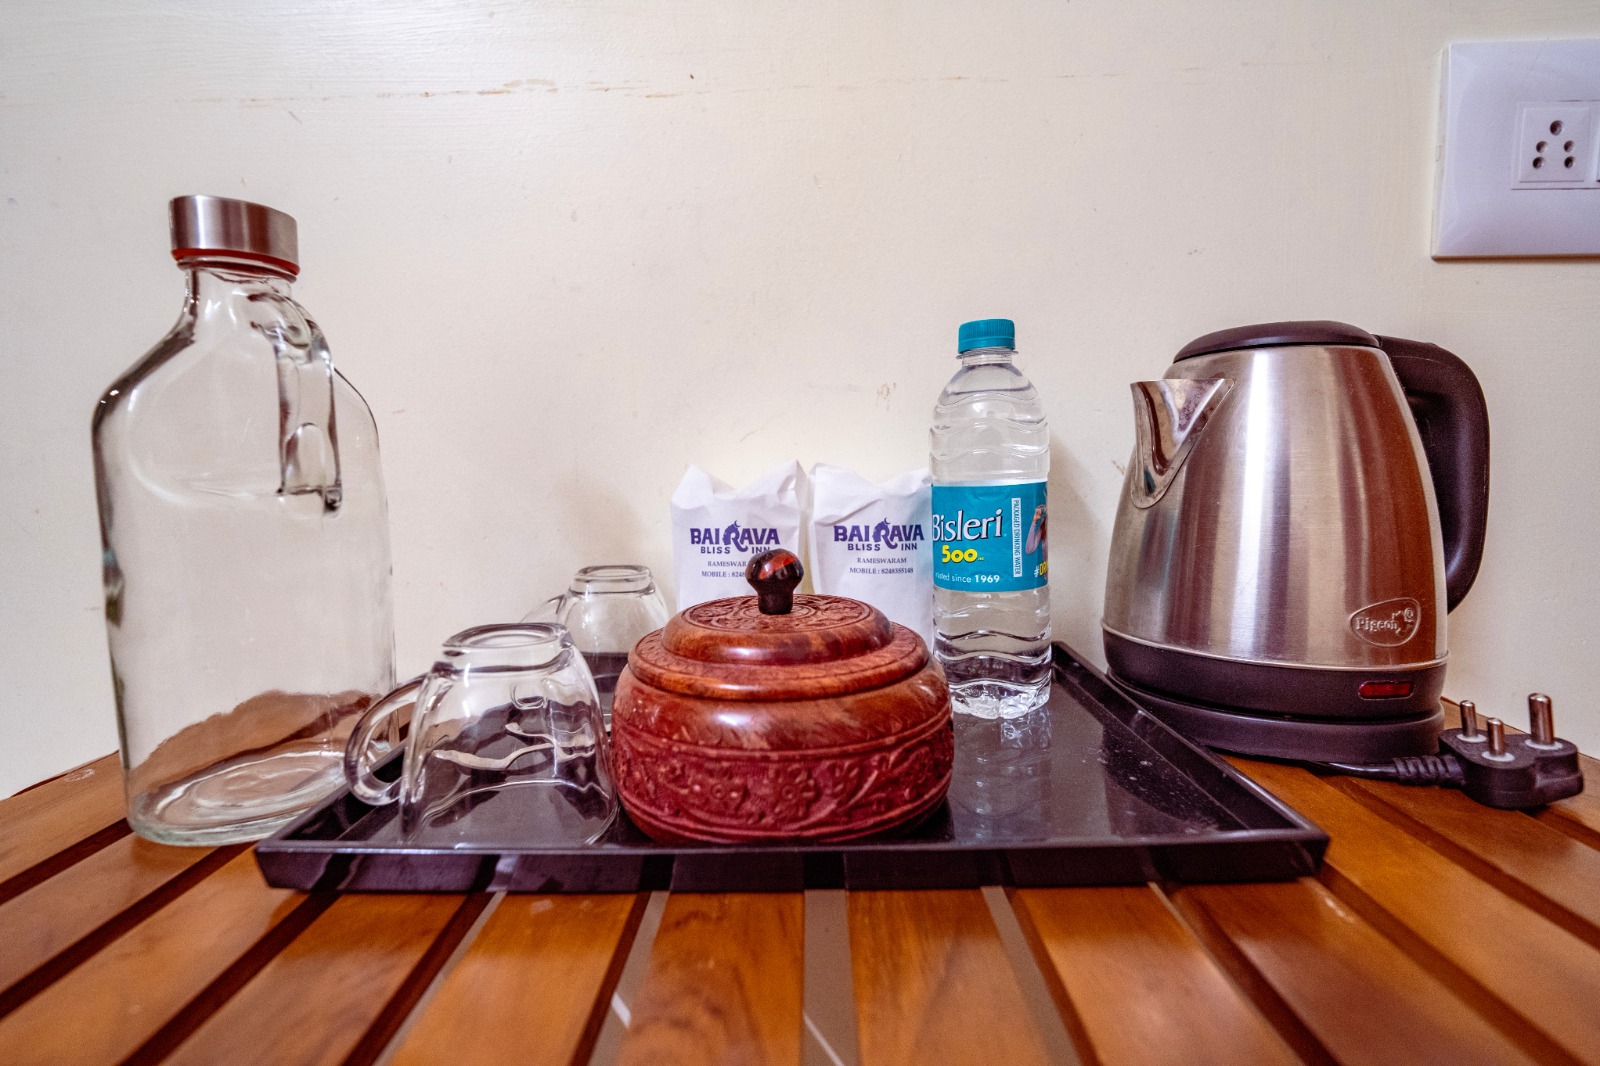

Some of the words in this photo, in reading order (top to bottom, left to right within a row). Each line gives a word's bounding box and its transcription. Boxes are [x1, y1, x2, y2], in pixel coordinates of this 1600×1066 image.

[1013, 499, 1021, 528] PACKAGED
[932, 508, 1003, 541] Bisleri
[689, 522, 781, 552] BAIRAVA
[834, 520, 925, 549] BAIRAVA
[700, 546, 731, 554] BLISS
[847, 543, 881, 551] BLISS
[901, 543, 917, 551] INN
[942, 545, 978, 563] 500
[1014, 557, 1022, 575] WATER
[935, 572, 951, 581] rusted
[951, 574, 972, 583] since
[974, 574, 1000, 583] 1969
[1355, 617, 1398, 632] Pigeon
